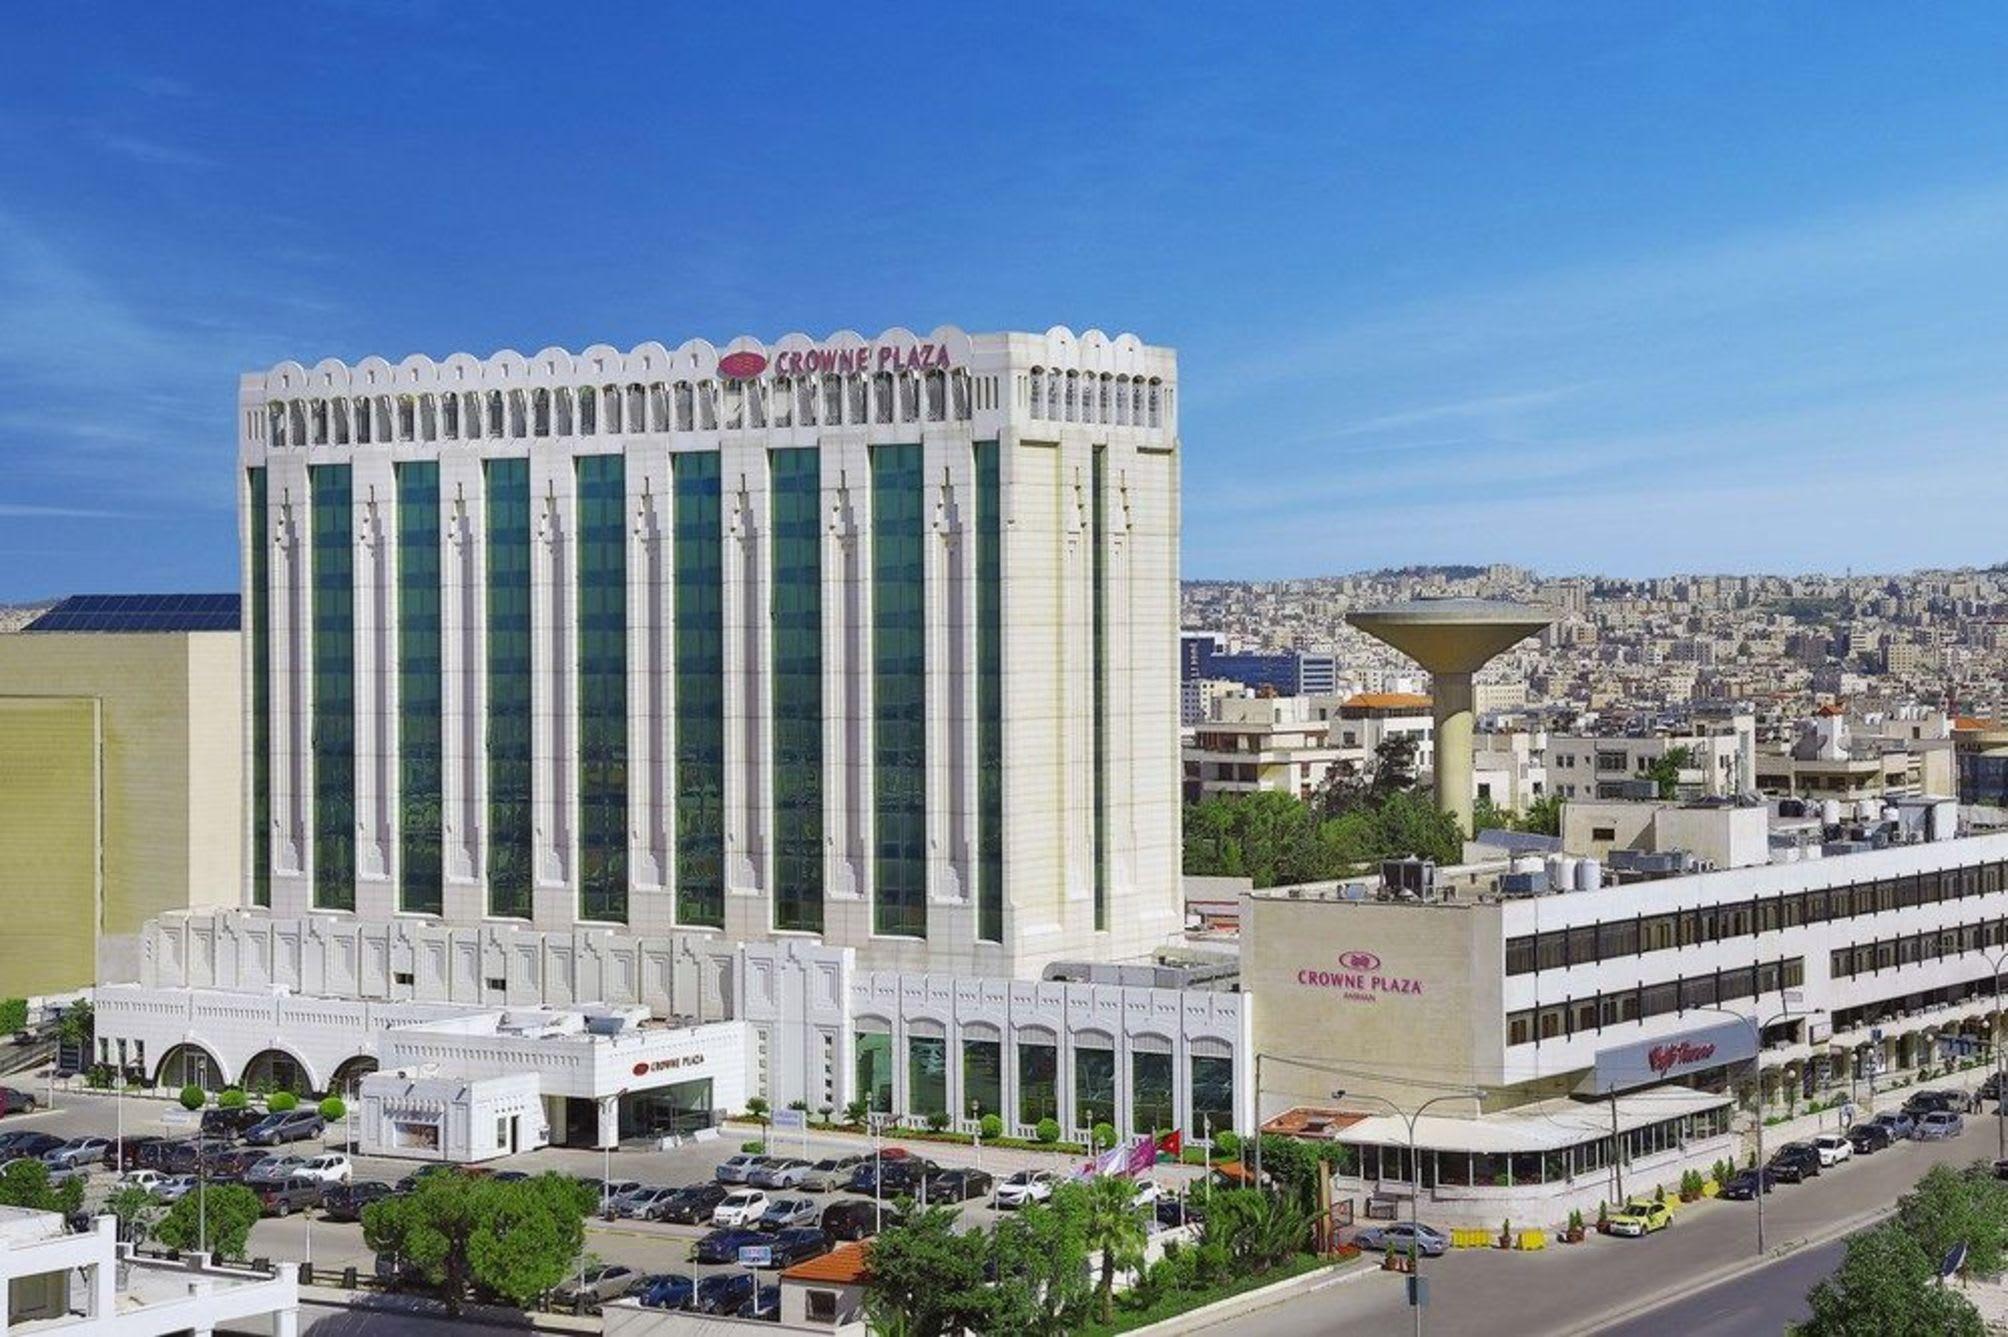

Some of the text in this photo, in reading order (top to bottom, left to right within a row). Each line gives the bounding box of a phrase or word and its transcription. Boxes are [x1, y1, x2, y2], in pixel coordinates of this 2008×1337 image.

[774, 344, 951, 377] CROWNE PLAZA
[1298, 970, 1422, 995] CROWNE PLAZA
